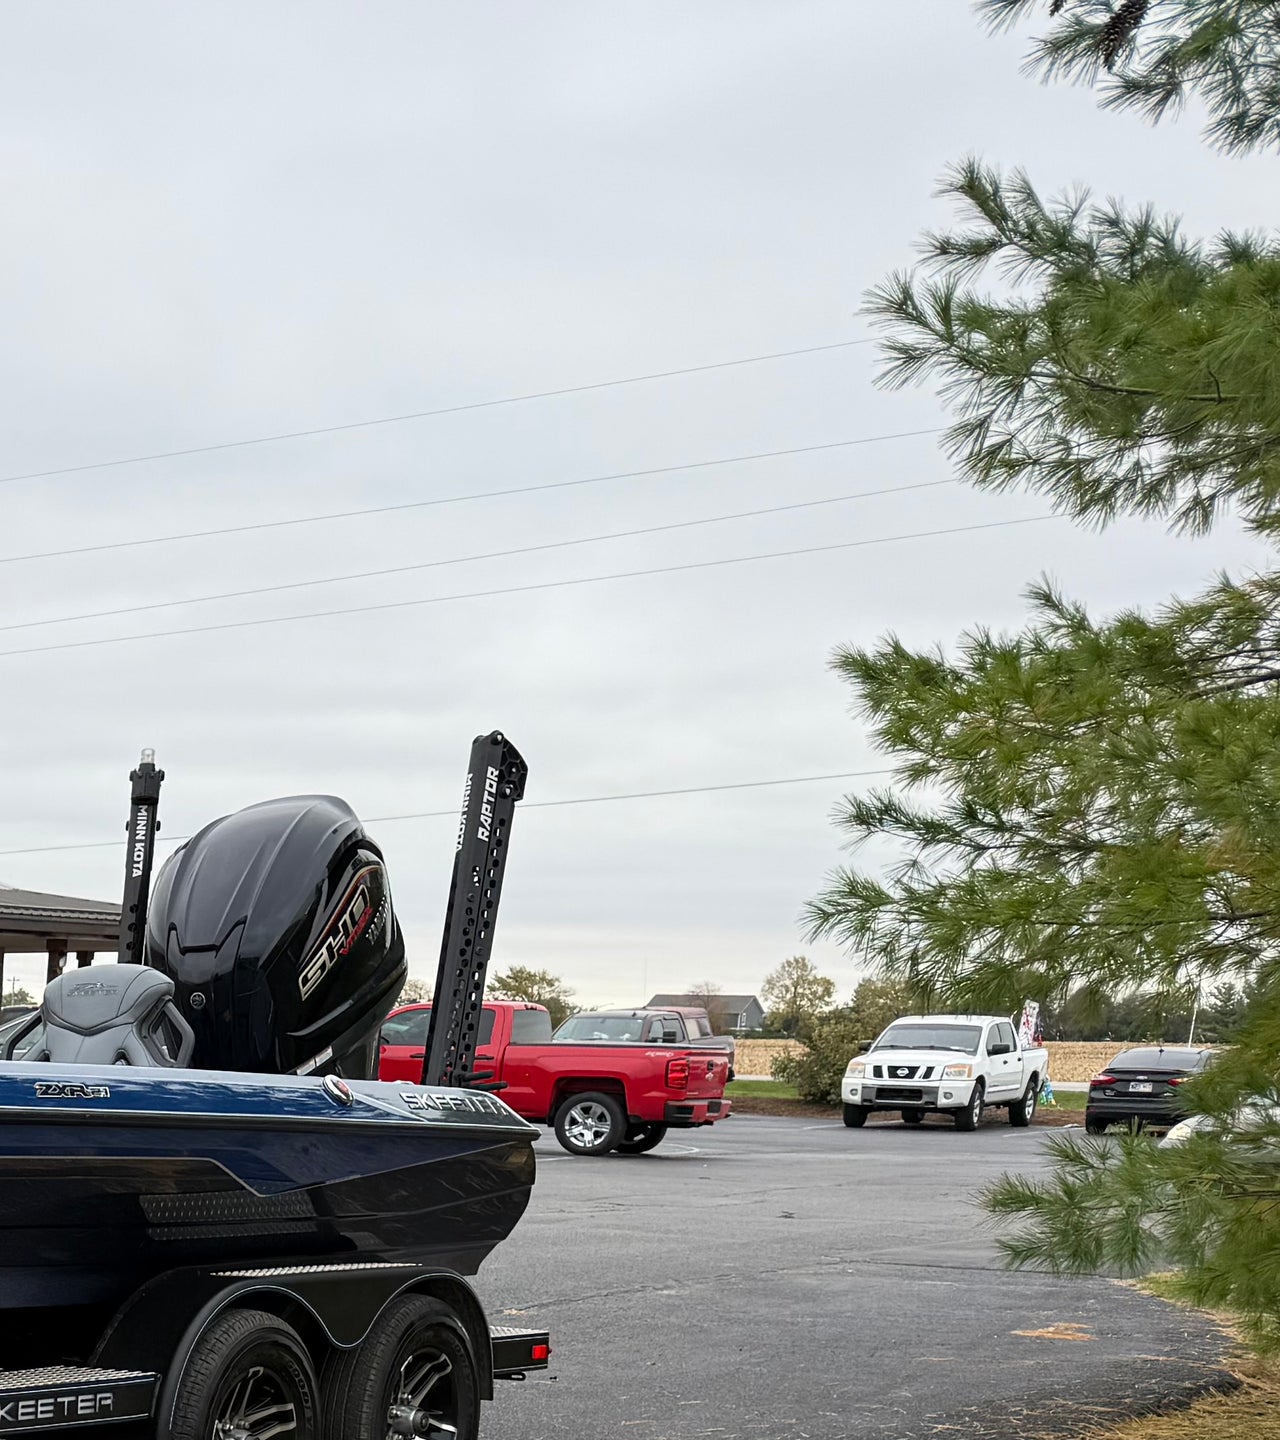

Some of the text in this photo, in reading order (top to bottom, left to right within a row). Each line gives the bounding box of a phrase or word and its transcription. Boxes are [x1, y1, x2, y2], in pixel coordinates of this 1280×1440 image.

[477, 765, 500, 842] RAPTOR
[131, 805, 149, 878] MINN KOTA
[298, 884, 371, 1002] SHO
[34, 1082, 90, 1099] ZXR
